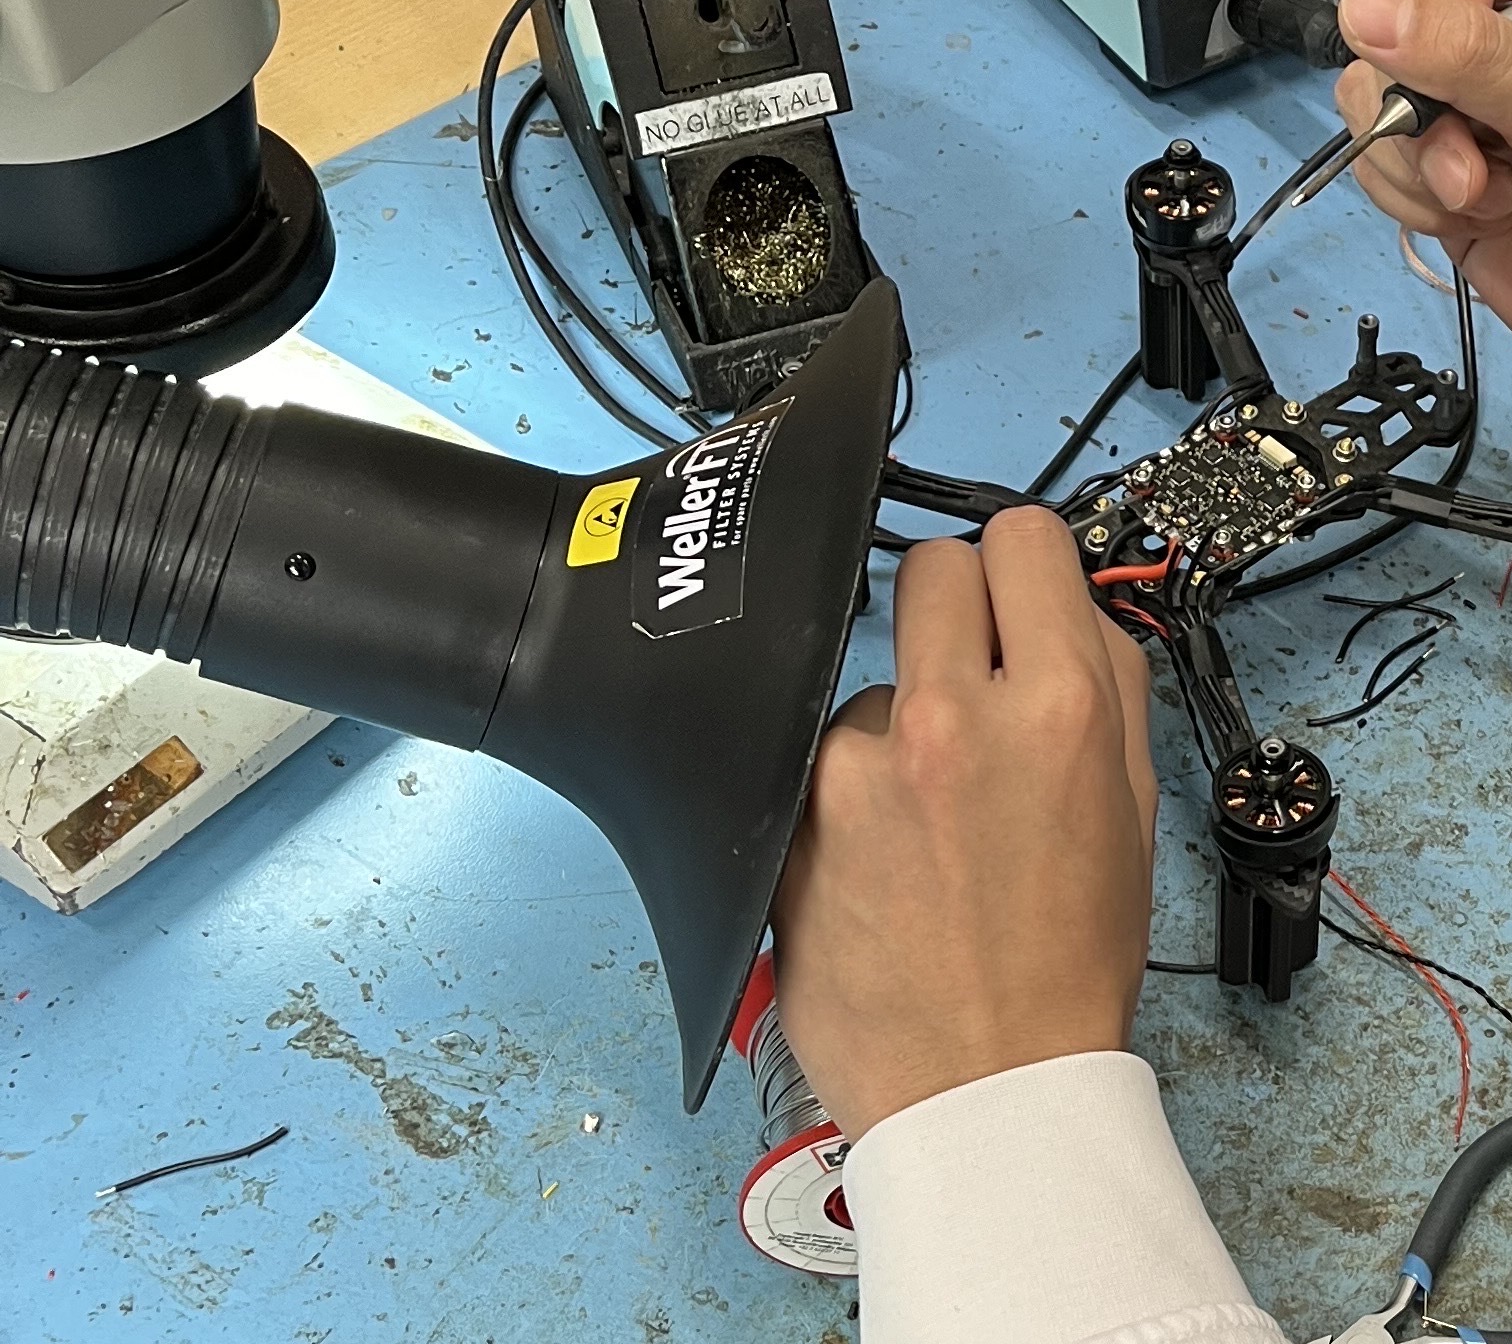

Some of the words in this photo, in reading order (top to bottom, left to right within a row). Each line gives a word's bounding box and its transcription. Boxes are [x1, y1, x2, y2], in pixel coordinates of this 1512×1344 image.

[645, 119, 680, 144] NO
[687, 104, 749, 133] GLUE
[755, 95, 782, 122] AT
[791, 85, 830, 111] ALL
[712, 487, 737, 549] FILTER
[727, 420, 765, 480] SYSTEMS
[735, 501, 748, 526] spare
